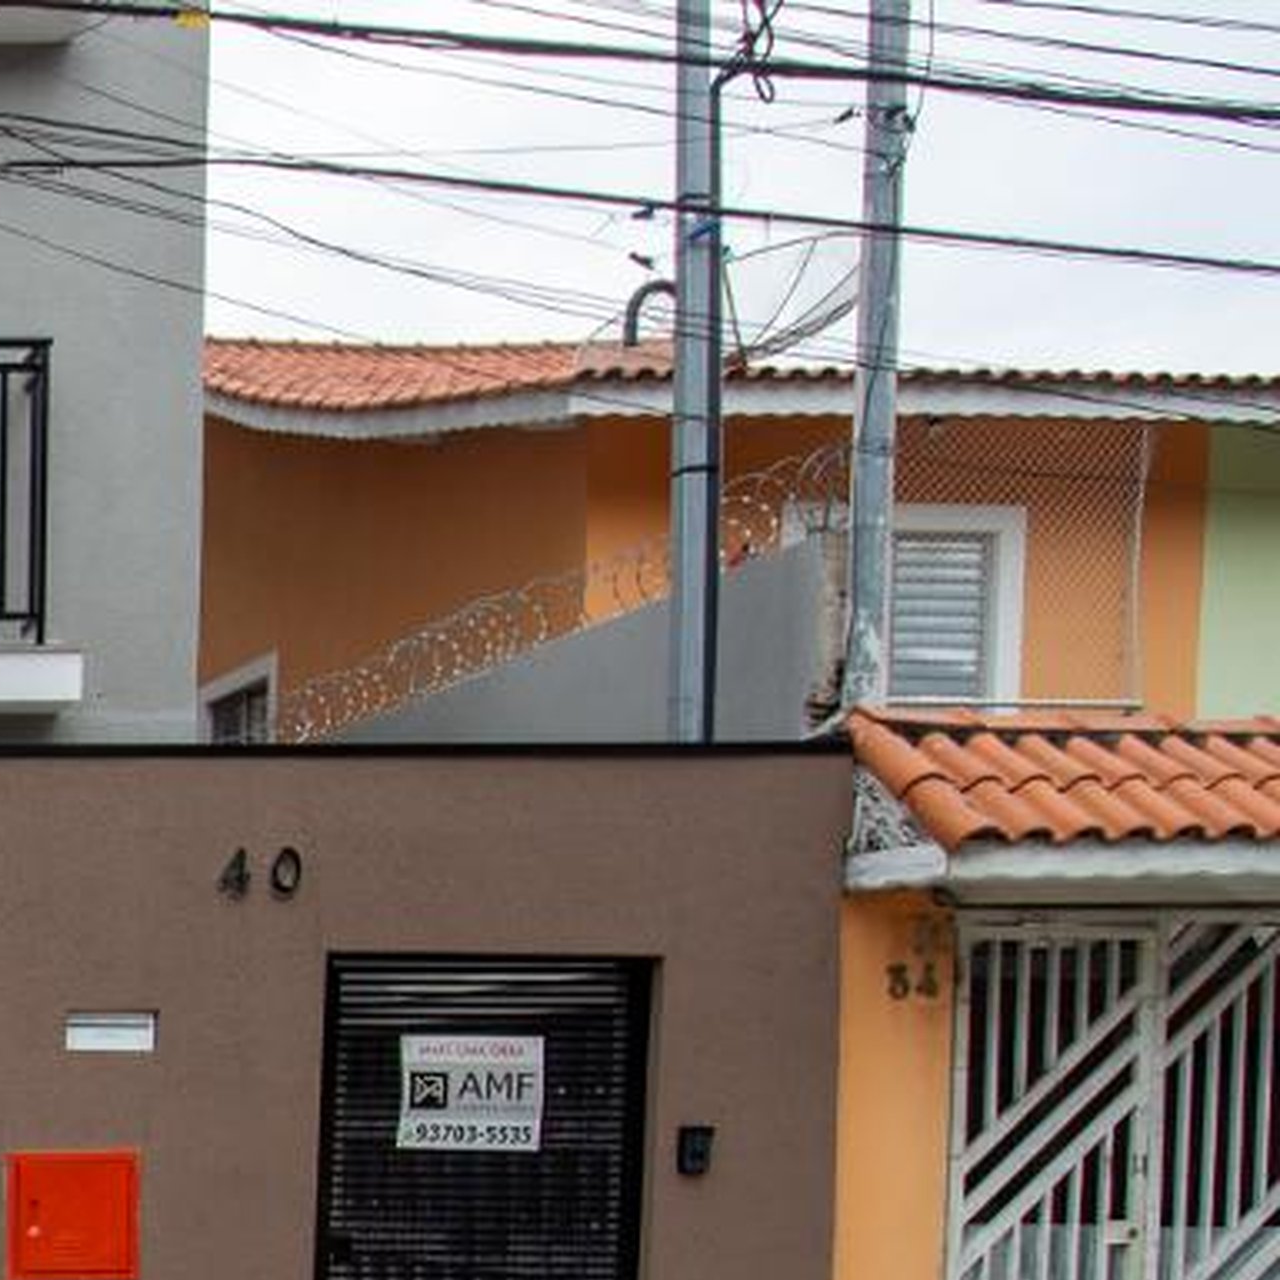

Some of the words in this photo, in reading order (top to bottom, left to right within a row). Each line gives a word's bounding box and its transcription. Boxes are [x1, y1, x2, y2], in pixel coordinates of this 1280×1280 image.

[218, 846, 302, 900] 40
[459, 1071, 534, 1100] AMF
[415, 1123, 533, 1144] 93703-5535
